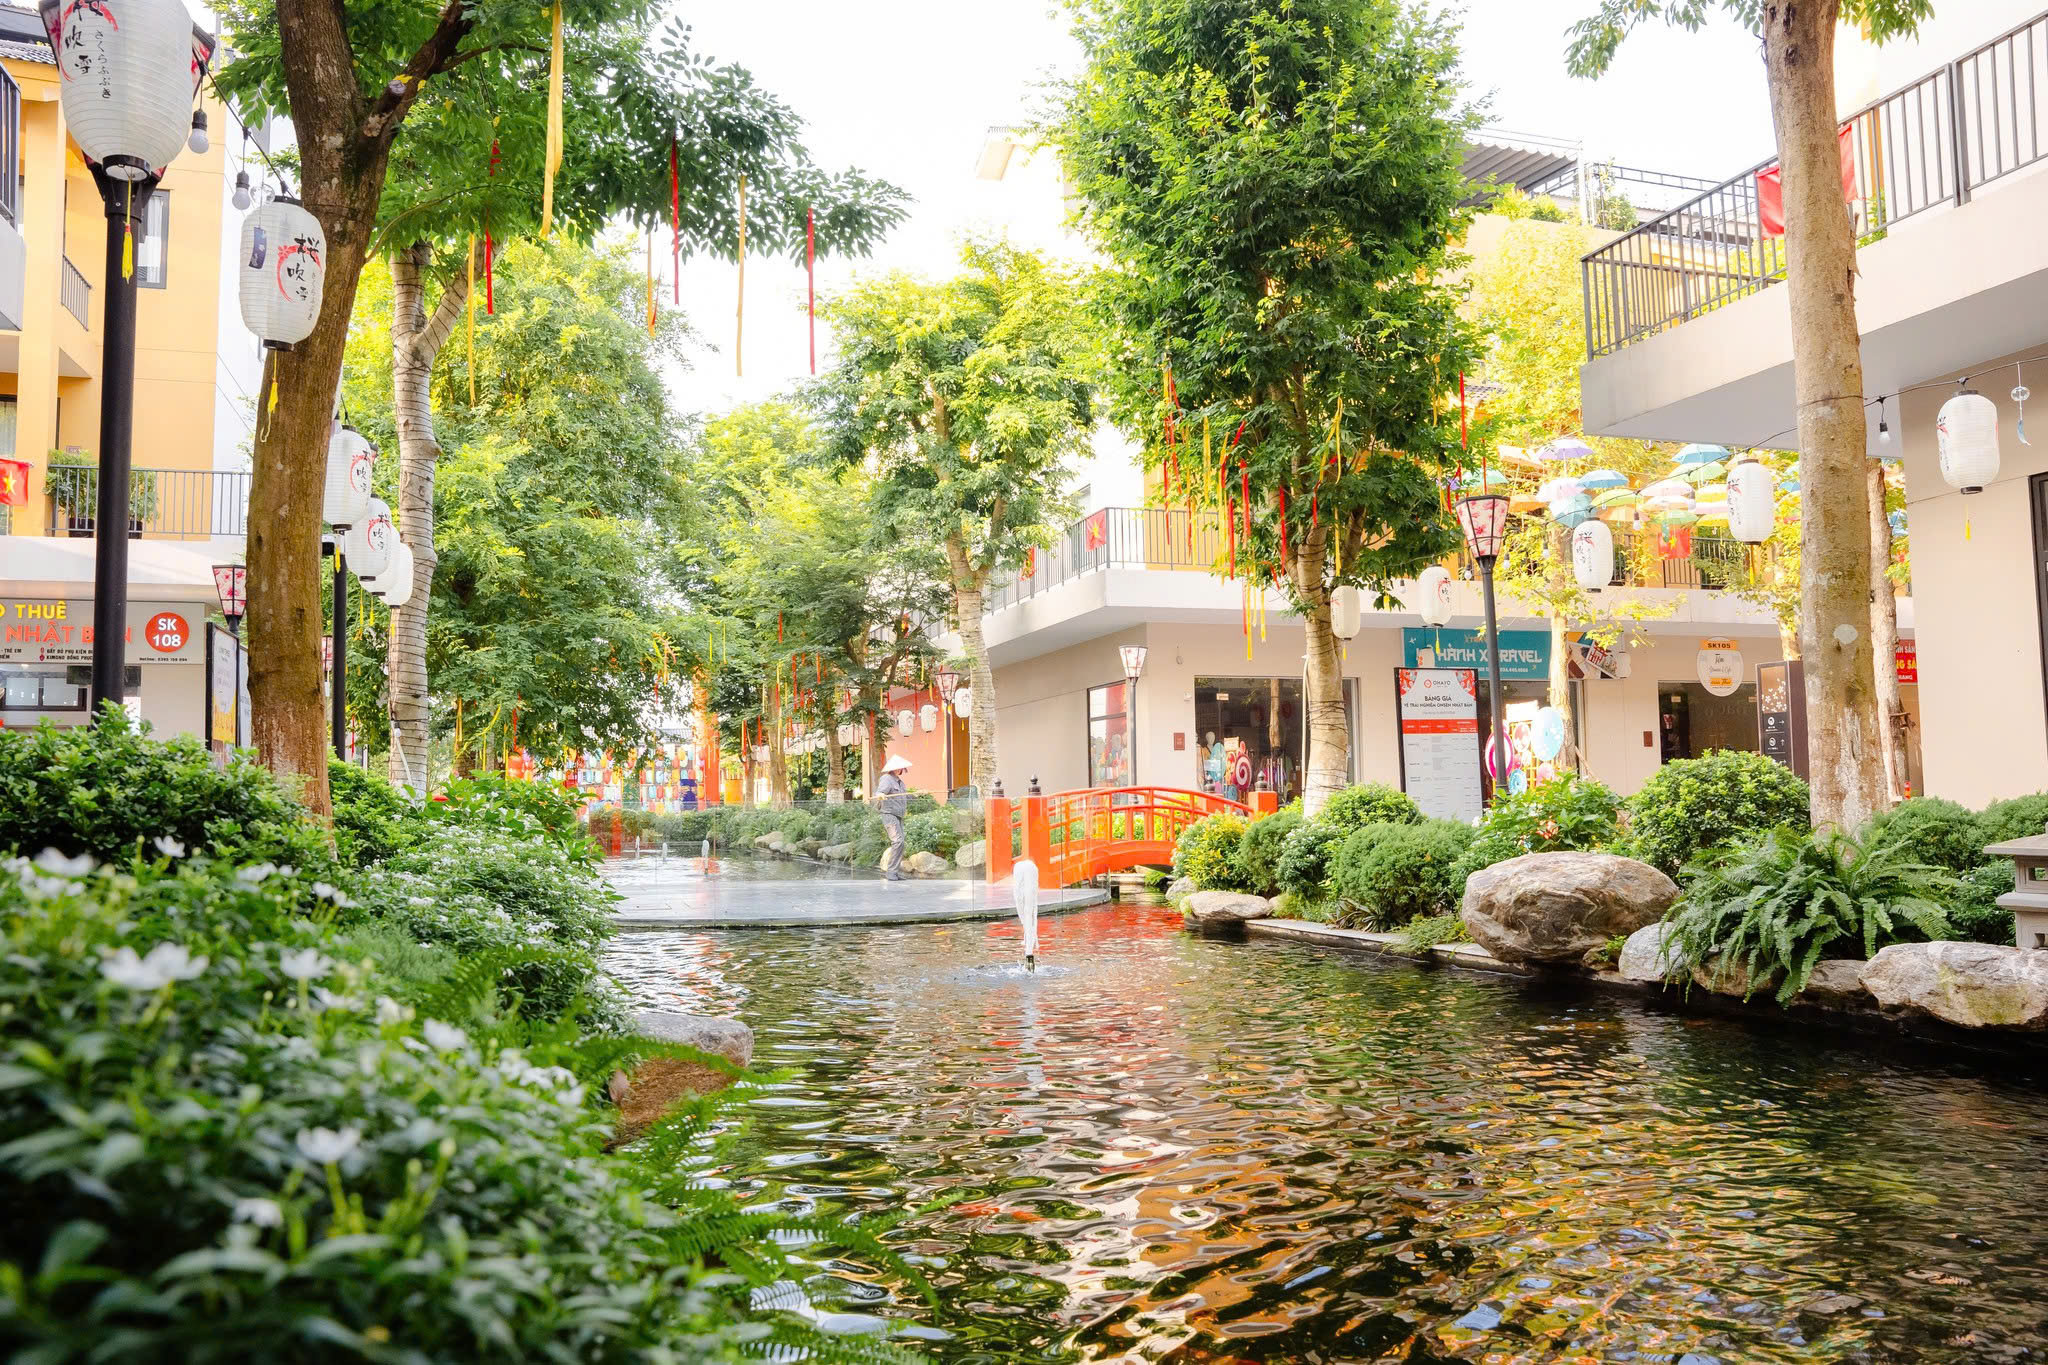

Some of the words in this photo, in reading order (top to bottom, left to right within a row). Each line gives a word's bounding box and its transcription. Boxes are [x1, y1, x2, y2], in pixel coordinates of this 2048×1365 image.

[15, 600, 67, 619] THUÊ
[158, 617, 177, 631] SK
[6, 620, 75, 646] NHẬT
[153, 633, 181, 647] 108
